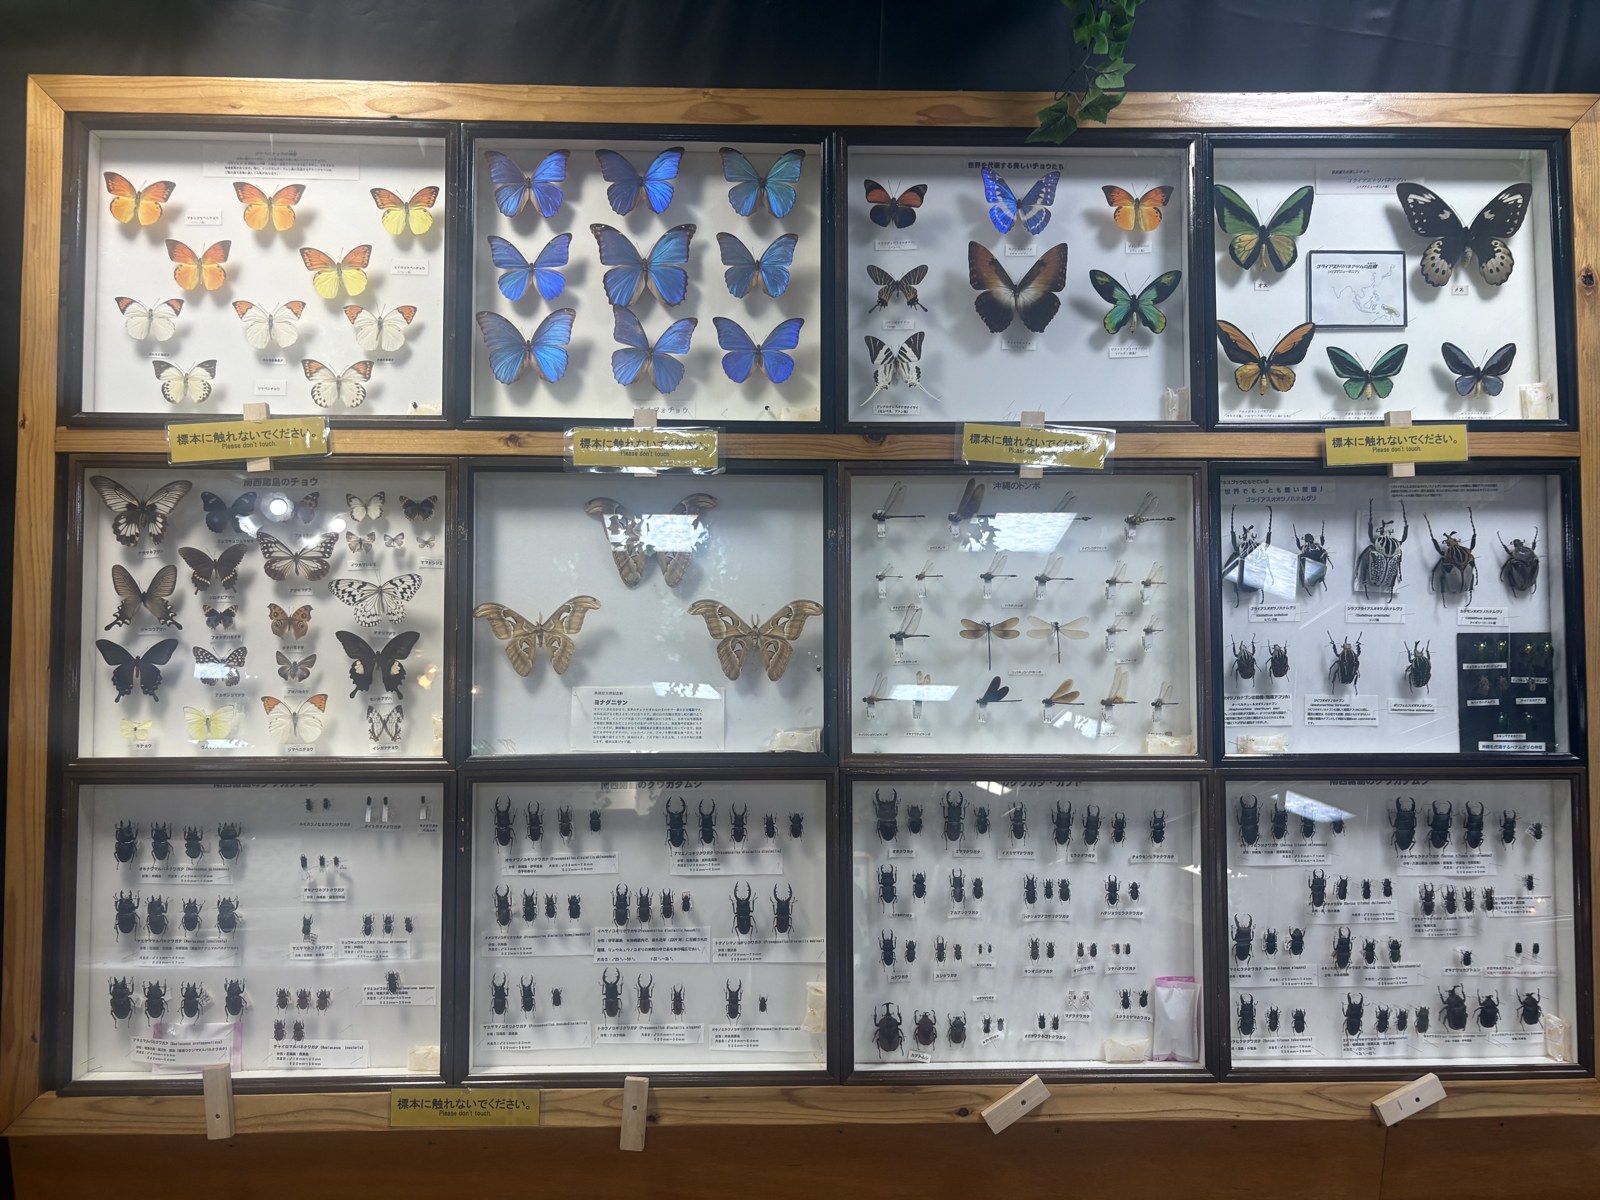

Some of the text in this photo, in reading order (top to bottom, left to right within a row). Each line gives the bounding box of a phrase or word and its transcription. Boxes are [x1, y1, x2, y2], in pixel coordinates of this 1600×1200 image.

[176, 427, 317, 446] 標本に触れないでください。
[969, 433, 1097, 453] 標本に触れないでくださ。
[1331, 433, 1458, 448] 標本に触れないでください。
[579, 437, 709, 452] 標本に触れないでください。
[243, 477, 318, 487] 南西諸島のチョウ
[993, 481, 1041, 491] 沖縄のトンボ
[911, 1053, 929, 1061] カブトムシ
[397, 1098, 531, 1110] 標本に触れないでください。
